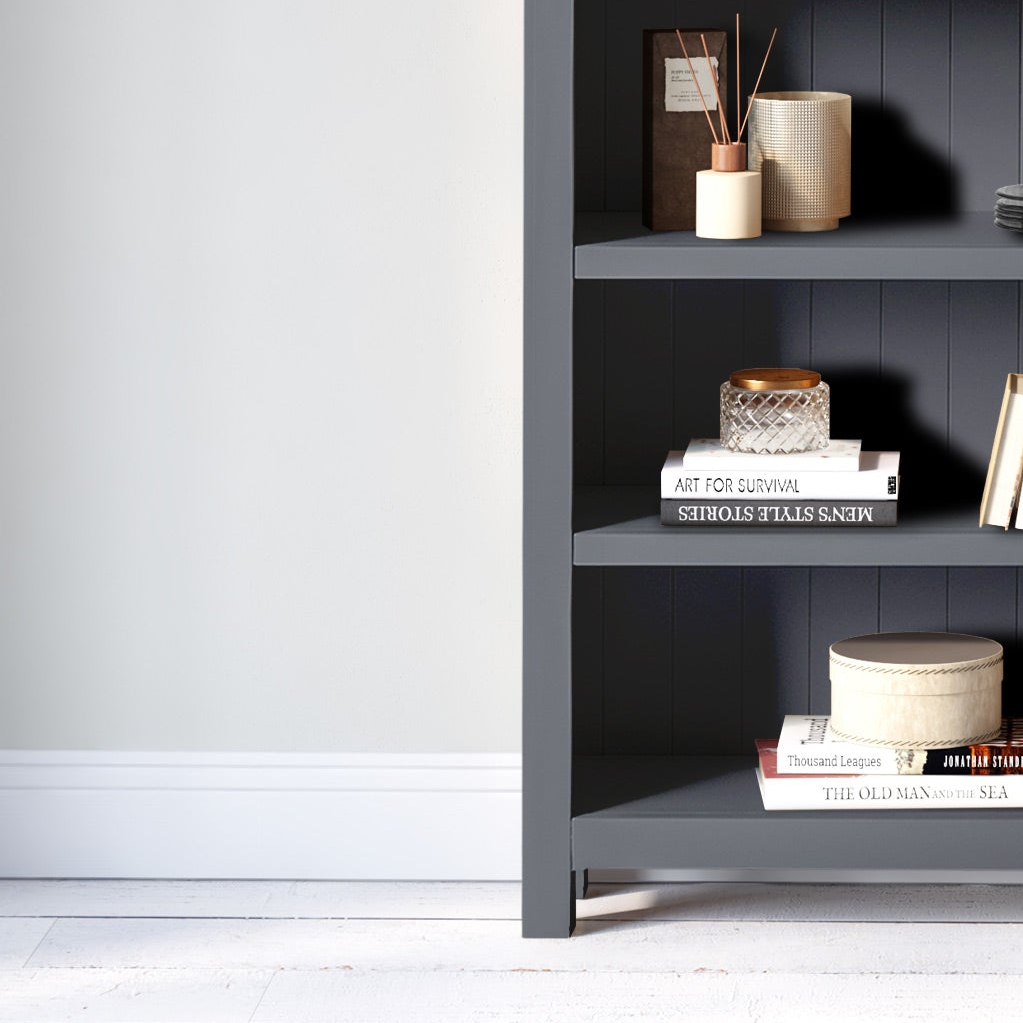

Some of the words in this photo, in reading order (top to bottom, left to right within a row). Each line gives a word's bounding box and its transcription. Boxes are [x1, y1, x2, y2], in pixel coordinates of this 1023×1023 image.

[674, 477, 700, 493] ART
[705, 477, 733, 493] FOR
[738, 478, 800, 493] SURVIVAL
[678, 505, 753, 522] STORIES
[758, 506, 814, 521] STYLE
[818, 506, 874, 522] MEN'S
[787, 754, 837, 767] Thousand
[840, 754, 882, 770] Leagues
[943, 754, 988, 768] JONATHAN
[823, 786, 855, 800] THE
[858, 785, 892, 800] OLD
[896, 785, 932, 799] MAN
[932, 789, 954, 799] AND
[955, 789, 976, 799] THE
[979, 785, 1008, 799] SEA
